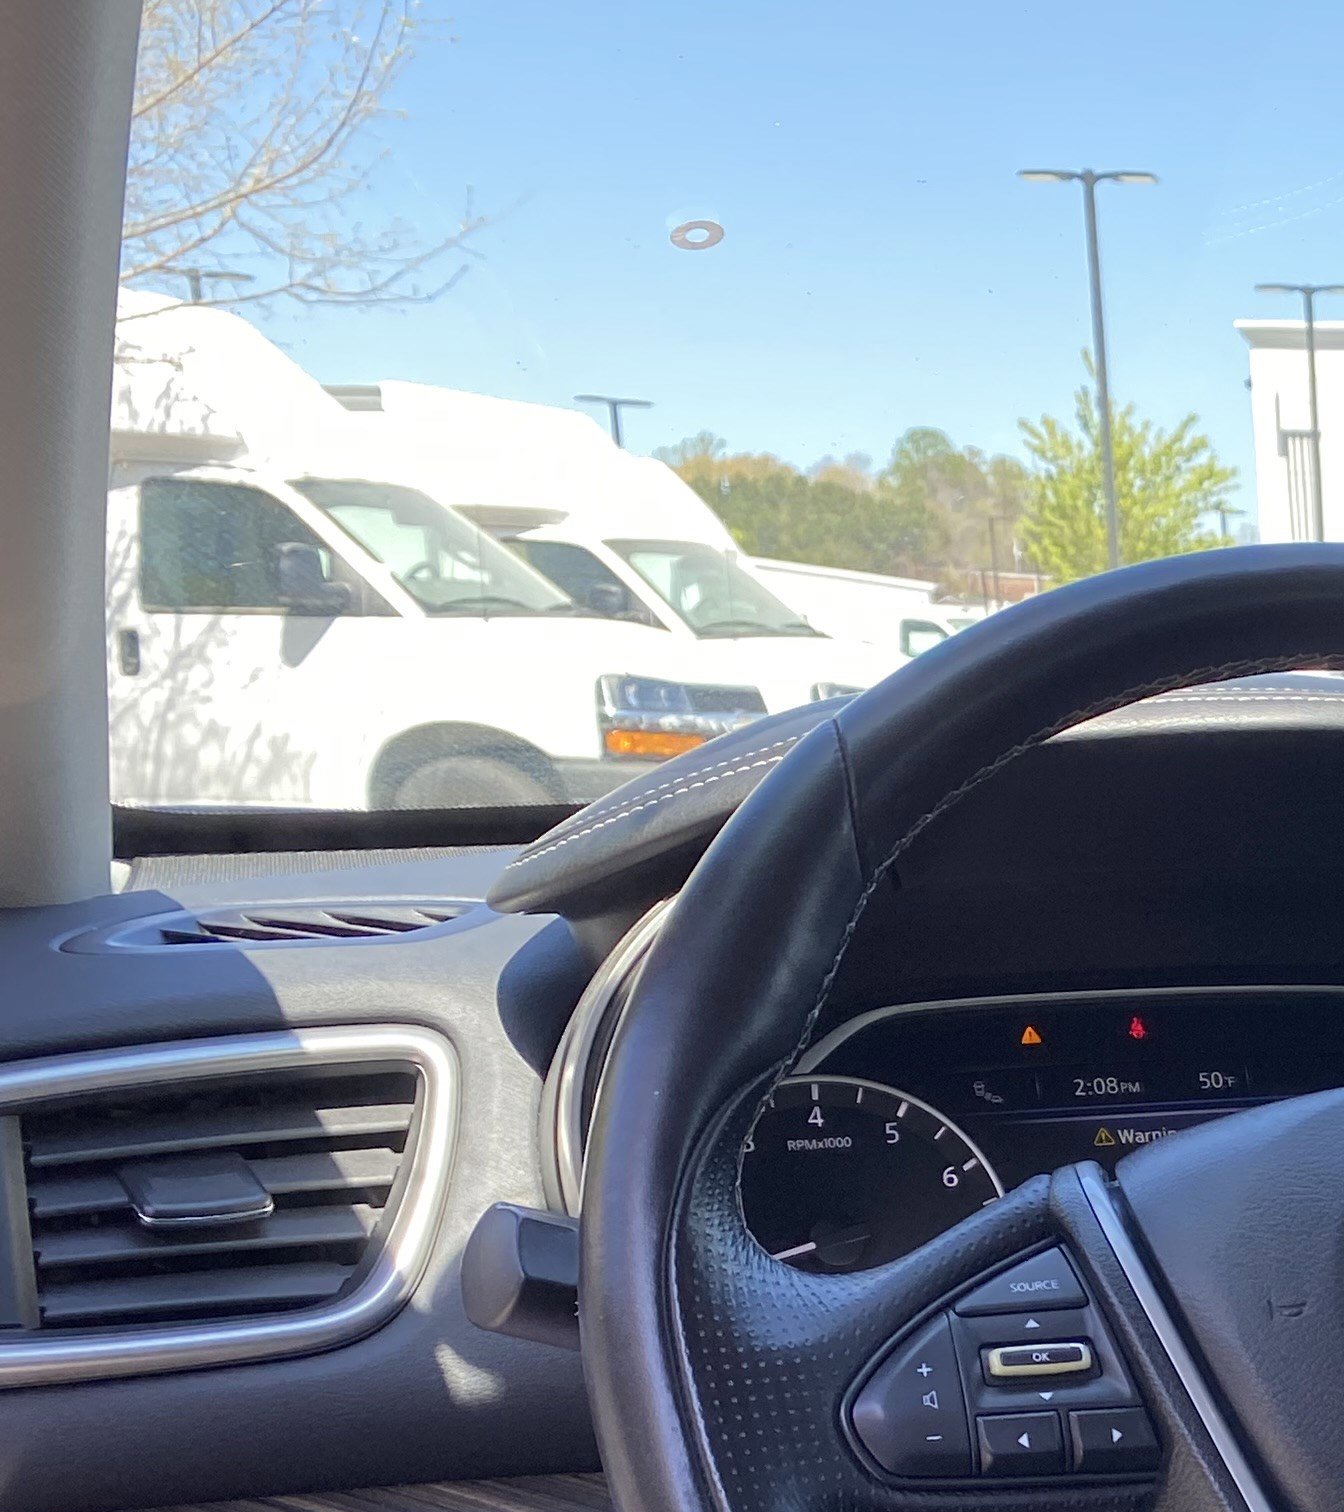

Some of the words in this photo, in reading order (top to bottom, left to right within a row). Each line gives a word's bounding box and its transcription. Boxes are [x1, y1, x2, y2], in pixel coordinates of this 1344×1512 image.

[807, 1106, 824, 1127] 4
[885, 1122, 900, 1143] 5
[942, 1166, 958, 1187] 6
[1009, 1278, 1060, 1293] SOURCE
[1031, 1351, 1050, 1362] OK
